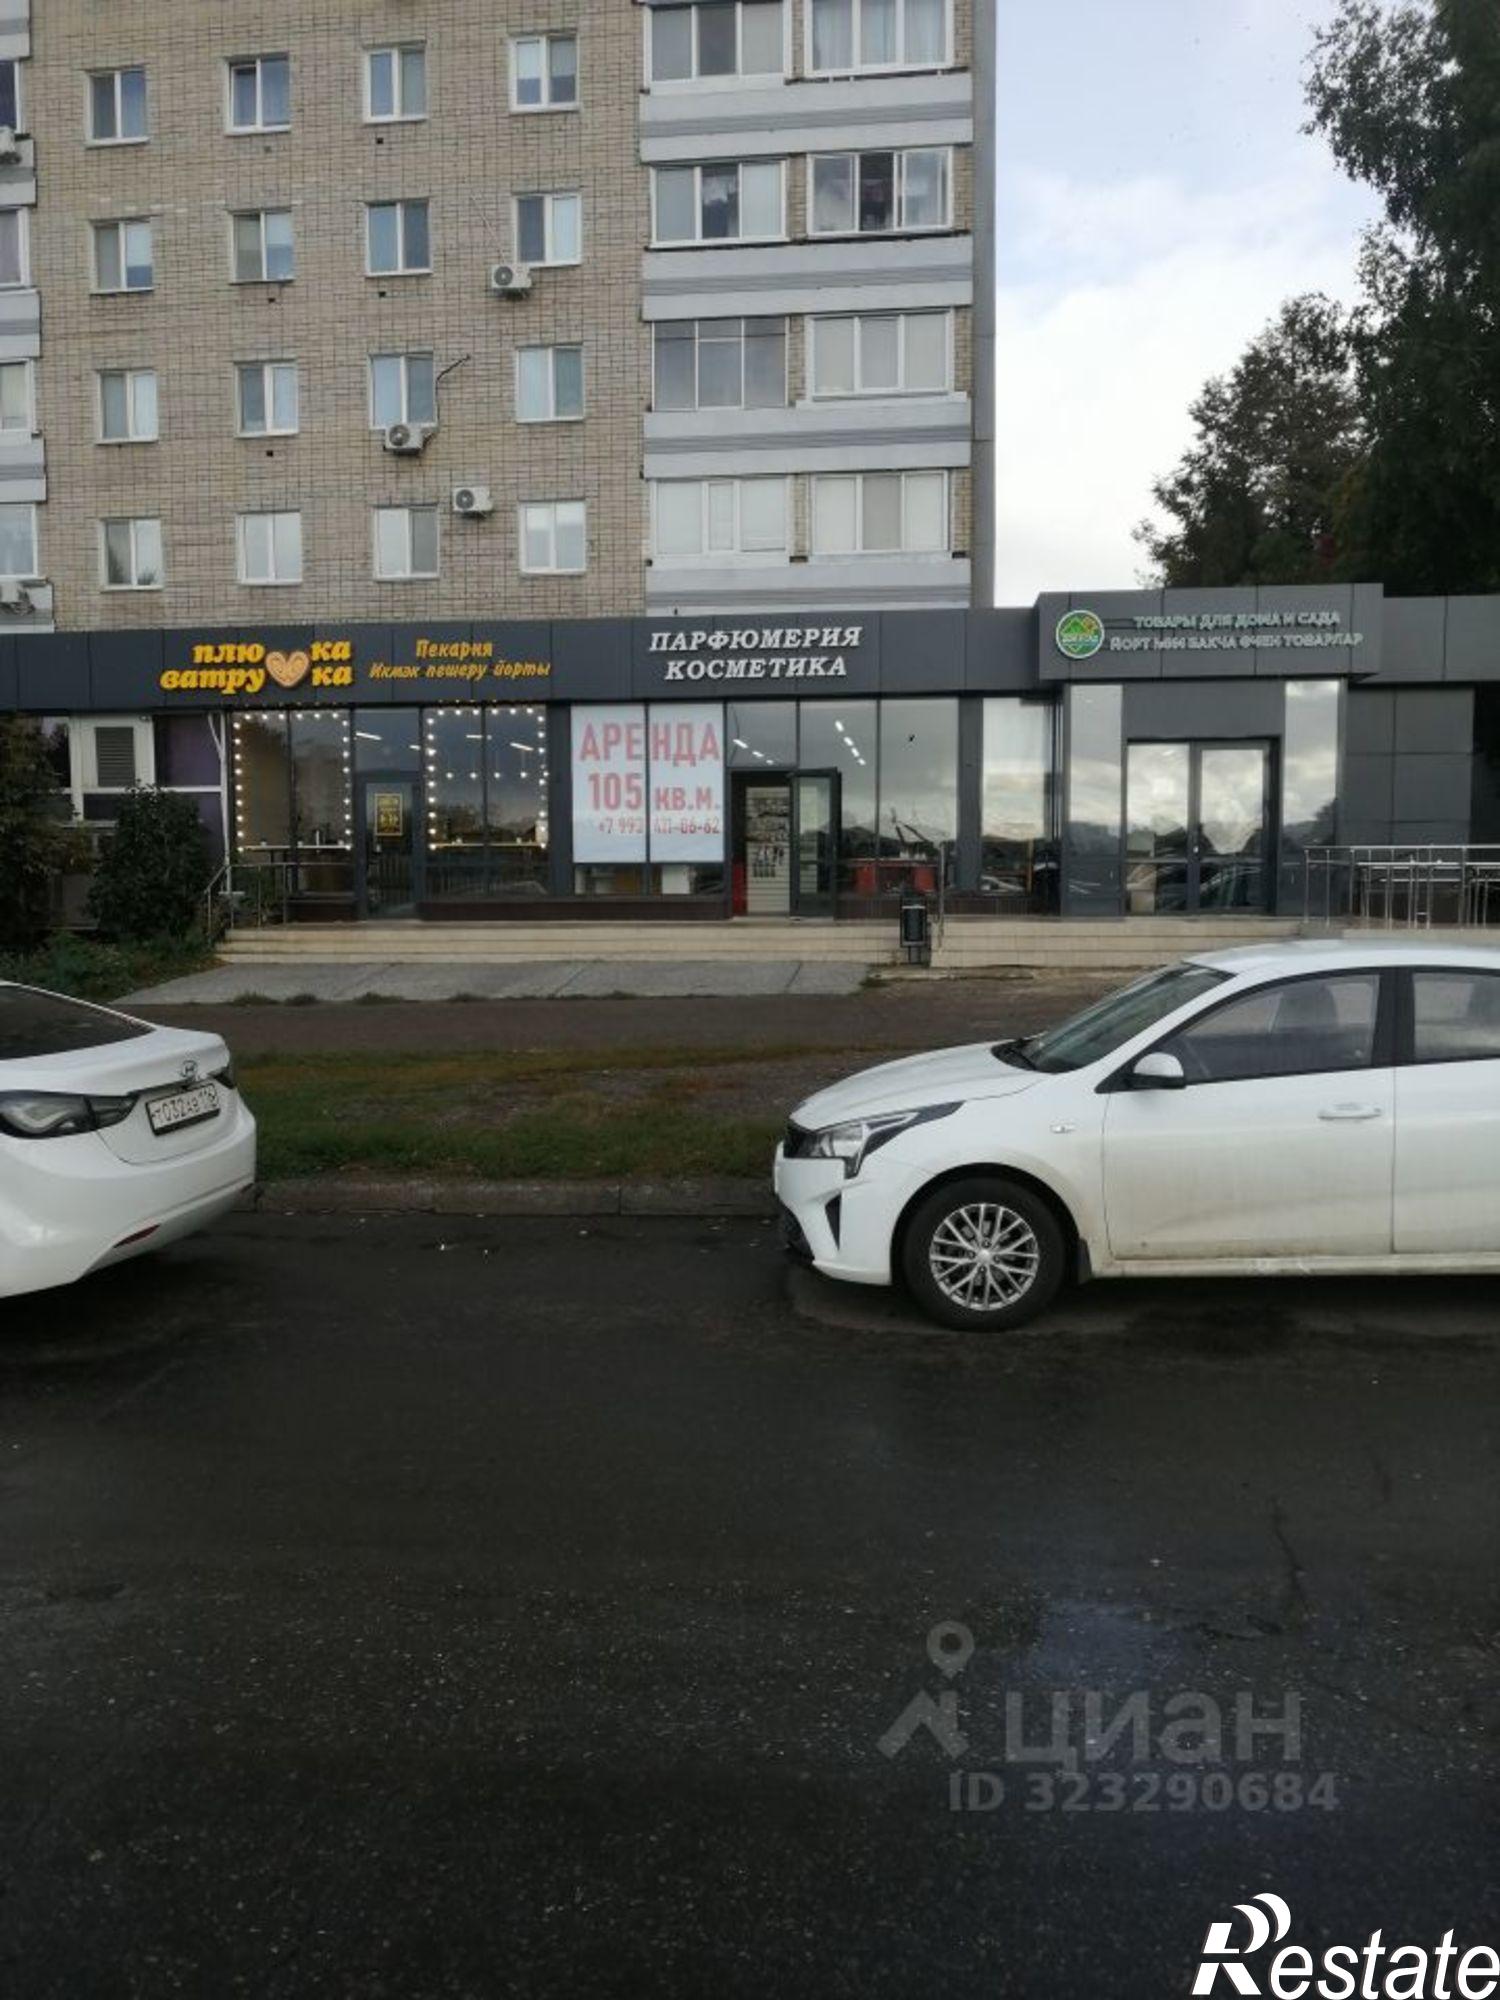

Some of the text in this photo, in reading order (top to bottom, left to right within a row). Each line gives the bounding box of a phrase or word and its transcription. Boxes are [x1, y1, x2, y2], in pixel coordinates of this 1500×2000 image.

[415, 638, 493, 661] Пекарня
[649, 626, 863, 651] ПАРФЮМЕРИЯ
[664, 655, 847, 681] КОСМЕТИКА
[579, 721, 722, 768] АРЕНДА
[588, 772, 643, 811] 105
